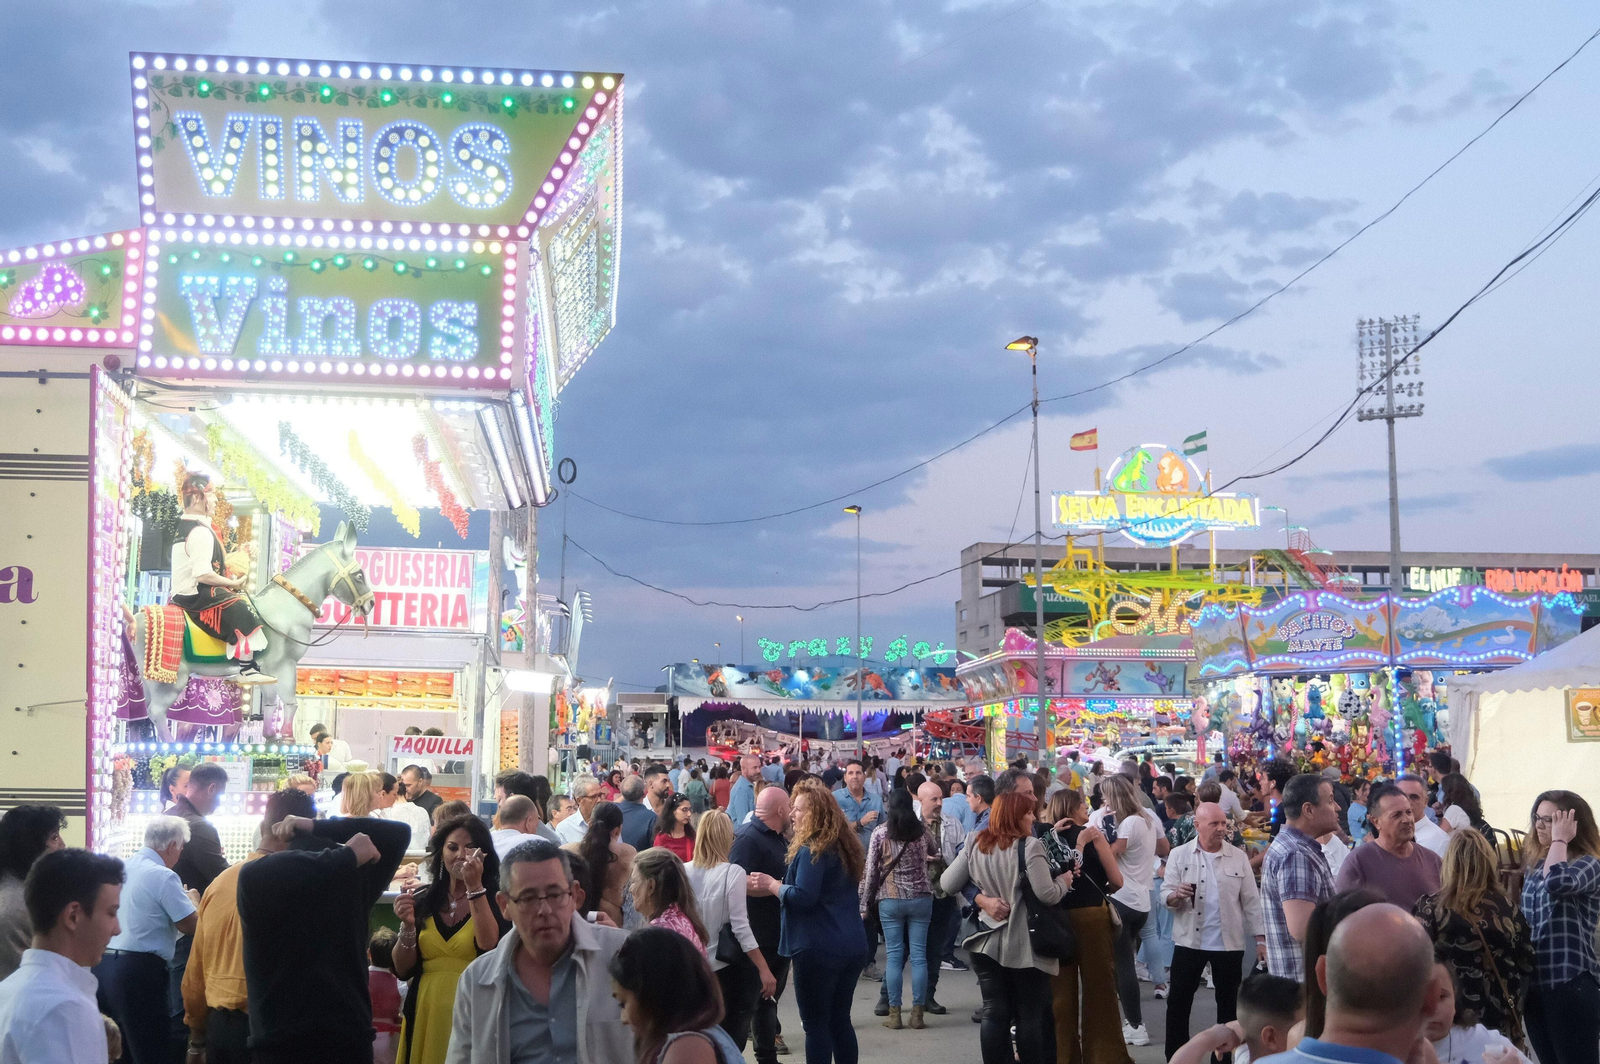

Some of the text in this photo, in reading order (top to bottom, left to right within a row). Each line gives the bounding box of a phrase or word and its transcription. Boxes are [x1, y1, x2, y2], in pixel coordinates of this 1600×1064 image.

[176, 111, 514, 209] VINOS
[179, 273, 481, 362] Vinos
[1058, 493, 1256, 526] SELVA ENCANTADA
[355, 550, 472, 589] RGUESERIA
[1409, 566, 1430, 591] EL
[313, 590, 470, 628] GUTTERIA
[1033, 590, 1086, 605] Cruzca
[1277, 613, 1355, 642] PATITOS
[1287, 637, 1344, 653] MAYTE
[393, 736, 474, 756] TAQUILLA
